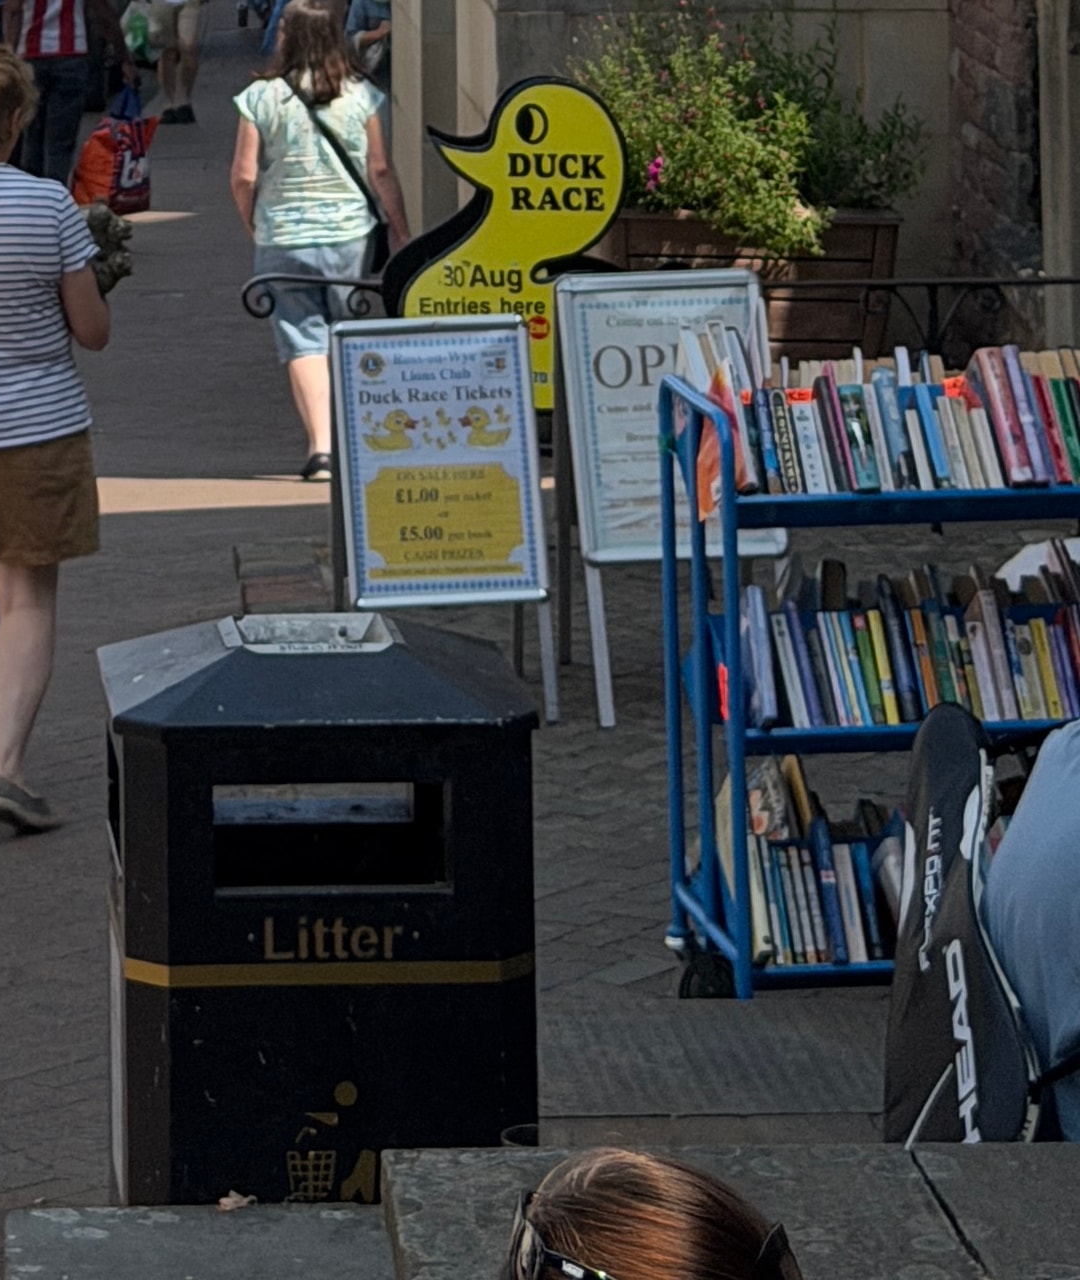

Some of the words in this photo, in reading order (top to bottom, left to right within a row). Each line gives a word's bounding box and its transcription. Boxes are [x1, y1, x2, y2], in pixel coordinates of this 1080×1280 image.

[508, 153, 606, 180] DUCK
[511, 187, 605, 212] RACE
[471, 264, 523, 294] Aug
[419, 298, 491, 315] Entries
[500, 297, 546, 315] here
[439, 367, 471, 381] Club
[359, 390, 402, 406] Duck
[407, 387, 448, 403] Race
[452, 384, 512, 401] Tickets
[396, 488, 439, 503] £1.00
[400, 526, 444, 542] £5.00
[263, 916, 403, 961] Litter
